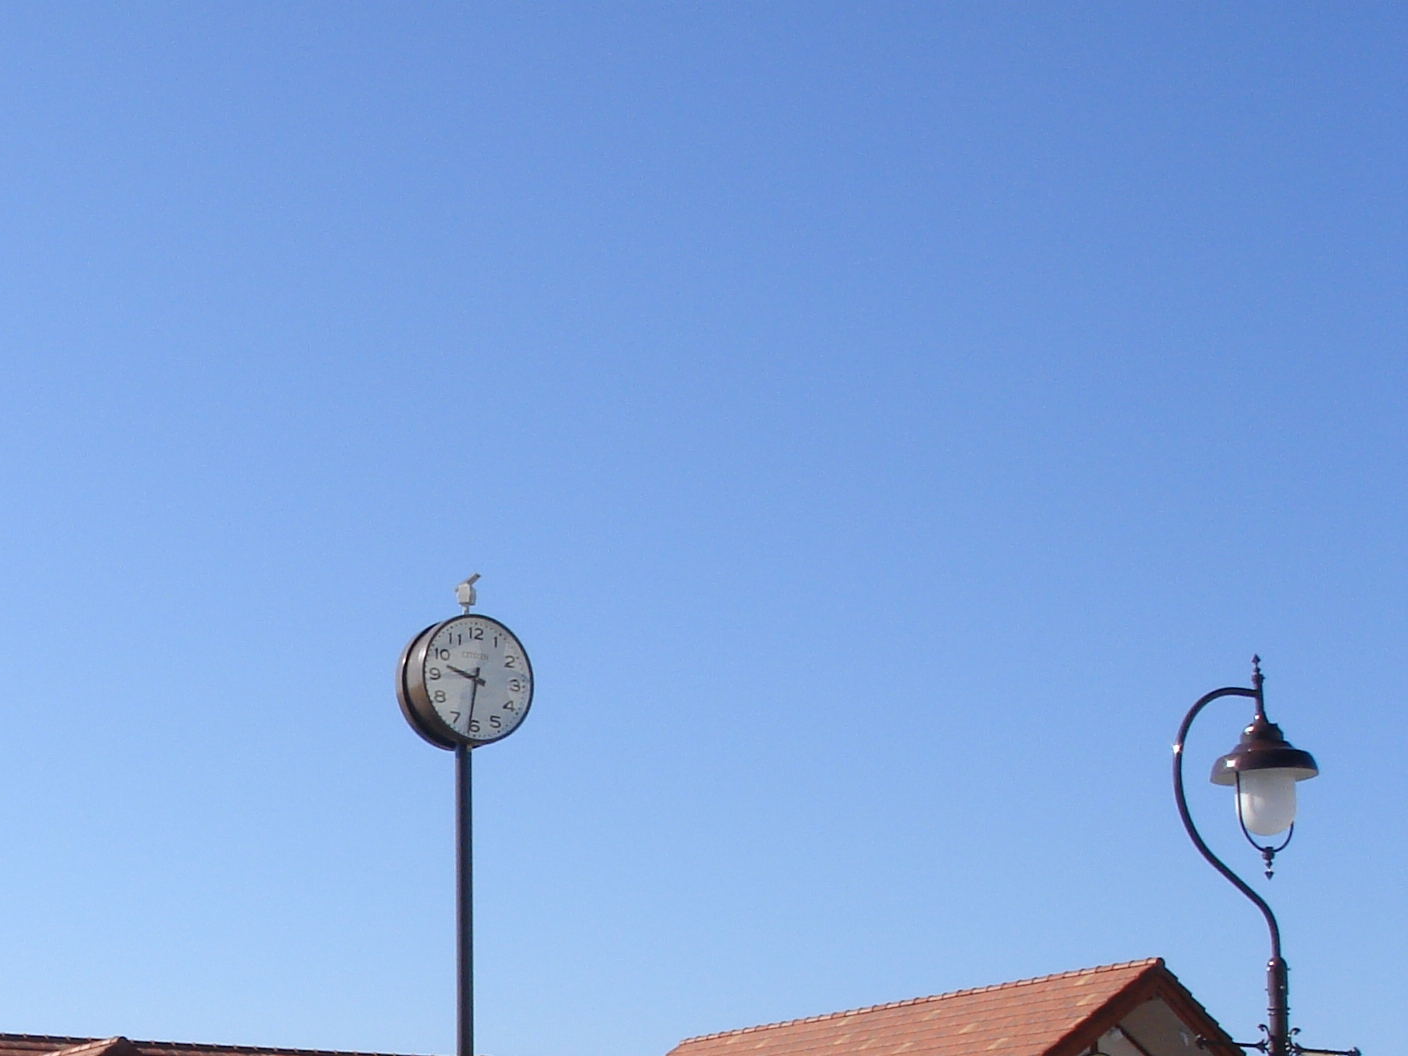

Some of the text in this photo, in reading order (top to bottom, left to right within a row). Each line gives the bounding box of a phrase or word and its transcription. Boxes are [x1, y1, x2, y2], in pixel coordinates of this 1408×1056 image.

[448, 632, 463, 646] 11
[468, 627, 484, 640] 12
[493, 636, 499, 648] 1
[434, 648, 450, 661] 10
[504, 655, 516, 669] 2
[428, 667, 441, 681] 9
[509, 678, 521, 692] 3
[433, 689, 447, 703] 8
[502, 700, 516, 712] 4
[449, 710, 461, 724] 7
[490, 715, 502, 729] 5
[469, 719, 481, 733] 6
